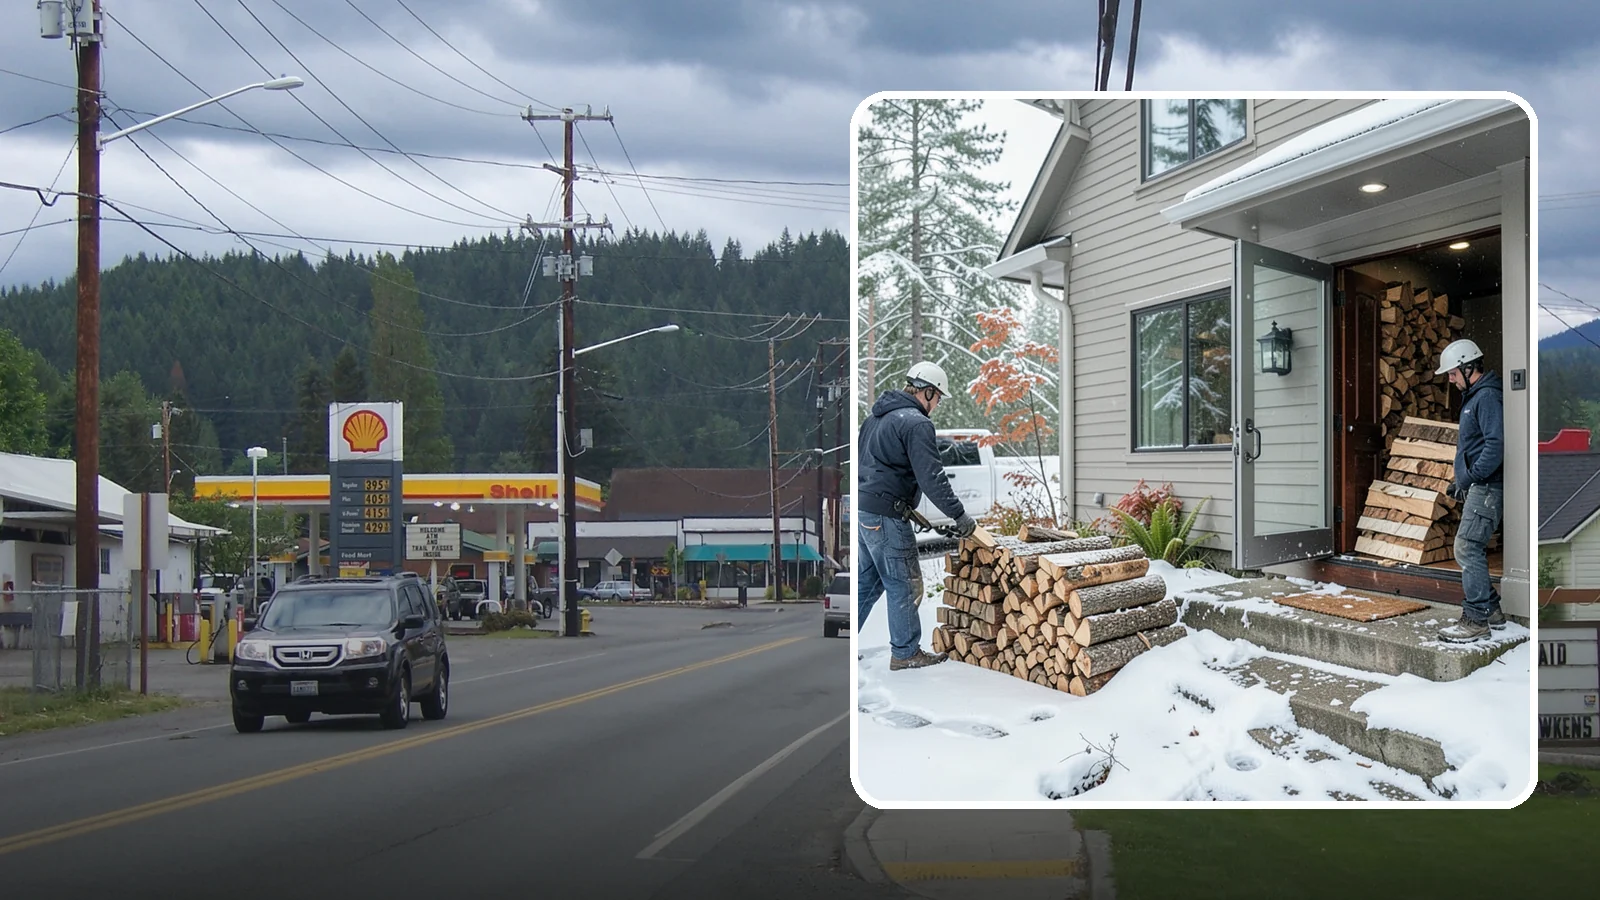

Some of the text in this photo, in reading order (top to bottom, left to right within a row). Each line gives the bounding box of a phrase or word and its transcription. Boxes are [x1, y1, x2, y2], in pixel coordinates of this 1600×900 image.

[365, 480, 383, 490] 395
[490, 484, 548, 499] Shell
[365, 494, 383, 504] 405
[365, 508, 383, 518] 415
[366, 522, 384, 533] 429
